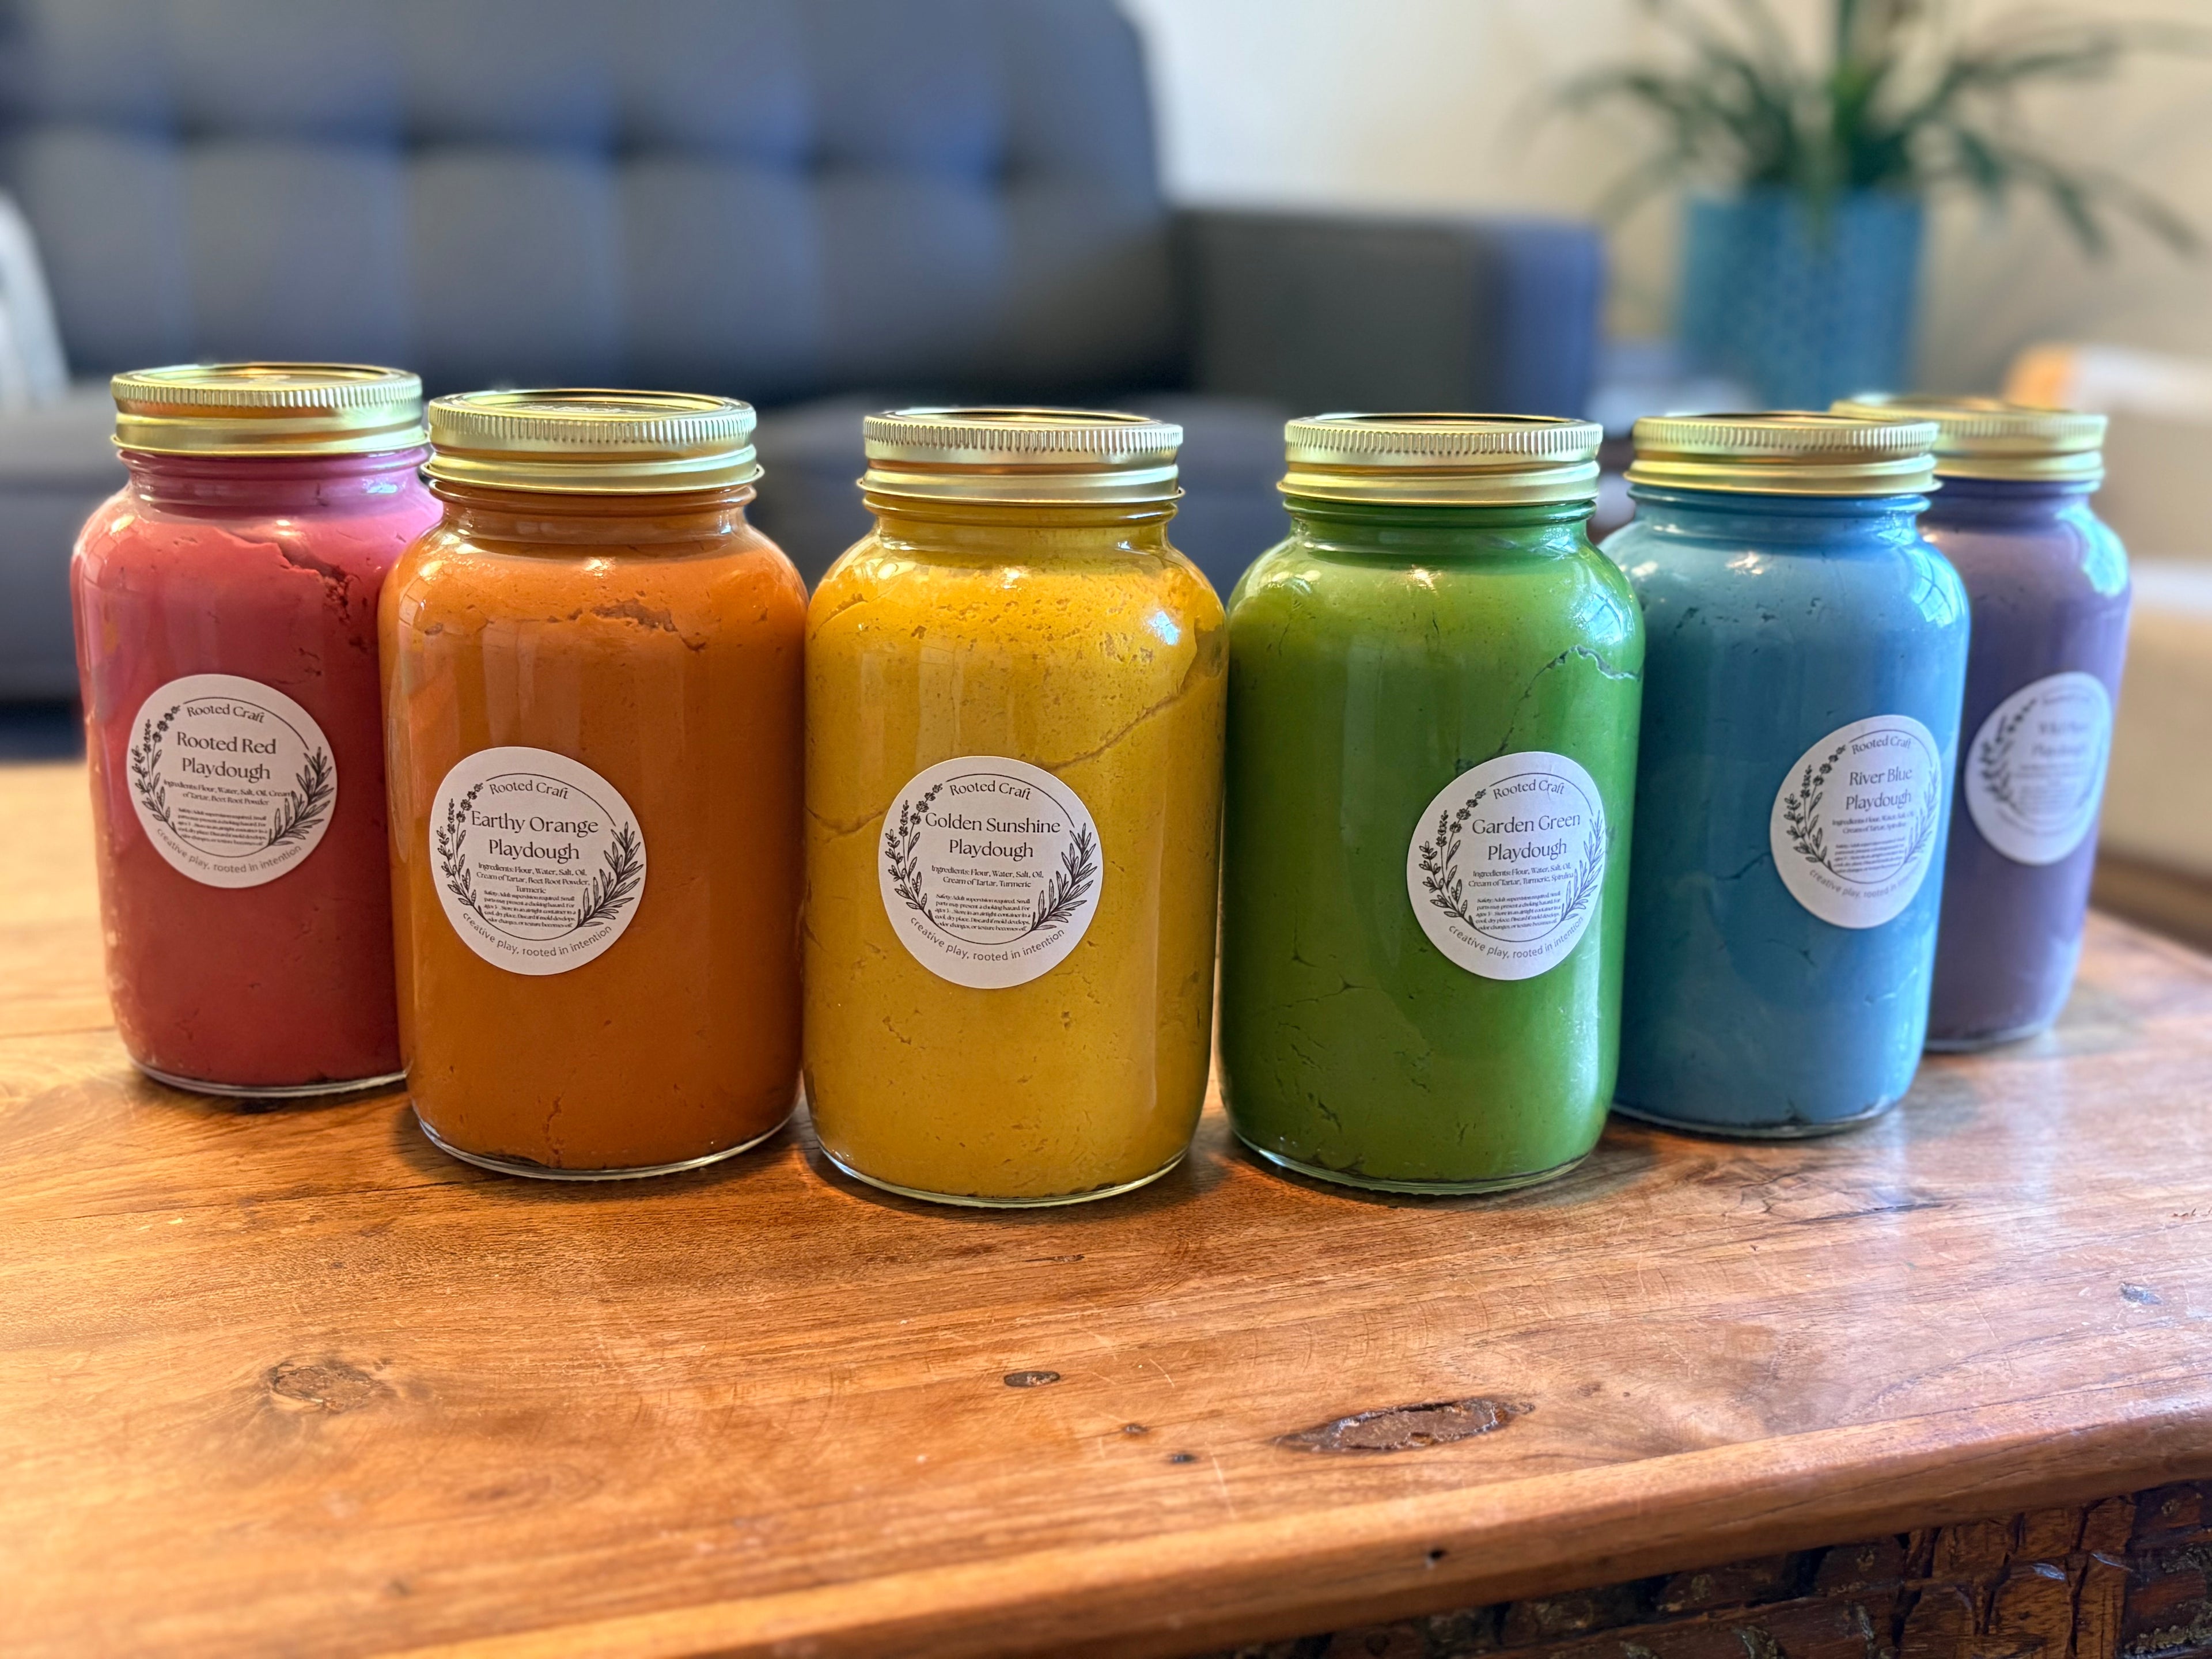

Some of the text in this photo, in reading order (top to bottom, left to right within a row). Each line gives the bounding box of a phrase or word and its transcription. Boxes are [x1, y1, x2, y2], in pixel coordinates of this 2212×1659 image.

[187, 703, 265, 724] Rooted Craft
[177, 731, 276, 755] Rooted Red
[1851, 734, 1911, 755] Rooted Craft
[182, 757, 271, 783] Playdough
[1849, 766, 1912, 786] River Blue
[218, 787, 240, 795] Water,
[490, 779, 569, 800] Rooted Craft
[949, 780, 1031, 800] Rooted Craft
[1493, 779, 1565, 800] Rooted Craft
[1846, 788, 1911, 812] Playdough
[472, 810, 599, 838] Earthy Orange
[925, 812, 1060, 834] Golden Sunshine
[1472, 814, 1581, 835] Garden Green
[157, 828, 188, 857] creative
[214, 863, 247, 873] rooted
[248, 863, 259, 872] in
[259, 846, 301, 869] intention
[489, 839, 579, 864] Playdough
[950, 838, 1033, 862] Playdough
[1487, 838, 1567, 863] Playdough
[476, 872, 498, 880] Cream
[505, 875, 528, 883] Tartar,
[514, 866, 535, 875] Flour,
[535, 868, 558, 876] Water,
[931, 865, 970, 876] Ingredients:
[971, 868, 991, 877] Flour,
[991, 870, 1014, 878] Water,
[1032, 870, 1044, 878] Oil,
[943, 876, 966, 885] Cream
[975, 879, 998, 887] Tartar,
[1473, 869, 1511, 879] Ingredients:
[1512, 868, 1530, 876] Flour,
[1531, 866, 1550, 874] Water,
[1522, 877, 1551, 885] Turmeric,
[516, 885, 547, 893] Turmeric
[1809, 869, 1842, 892] creative
[1863, 887, 1889, 898] rooted
[463, 912, 495, 942] creative
[497, 939, 519, 955] play,
[522, 946, 557, 957] rooted
[559, 946, 569, 955] in
[571, 925, 612, 952] intention
[911, 916, 1065, 961] creative play, rooted in intention
[1449, 925, 1486, 952] creative
[1487, 946, 1510, 959] play,
[1513, 945, 1543, 959] rooted
[1545, 943, 1553, 953] in
[1554, 916, 1584, 948] intention
